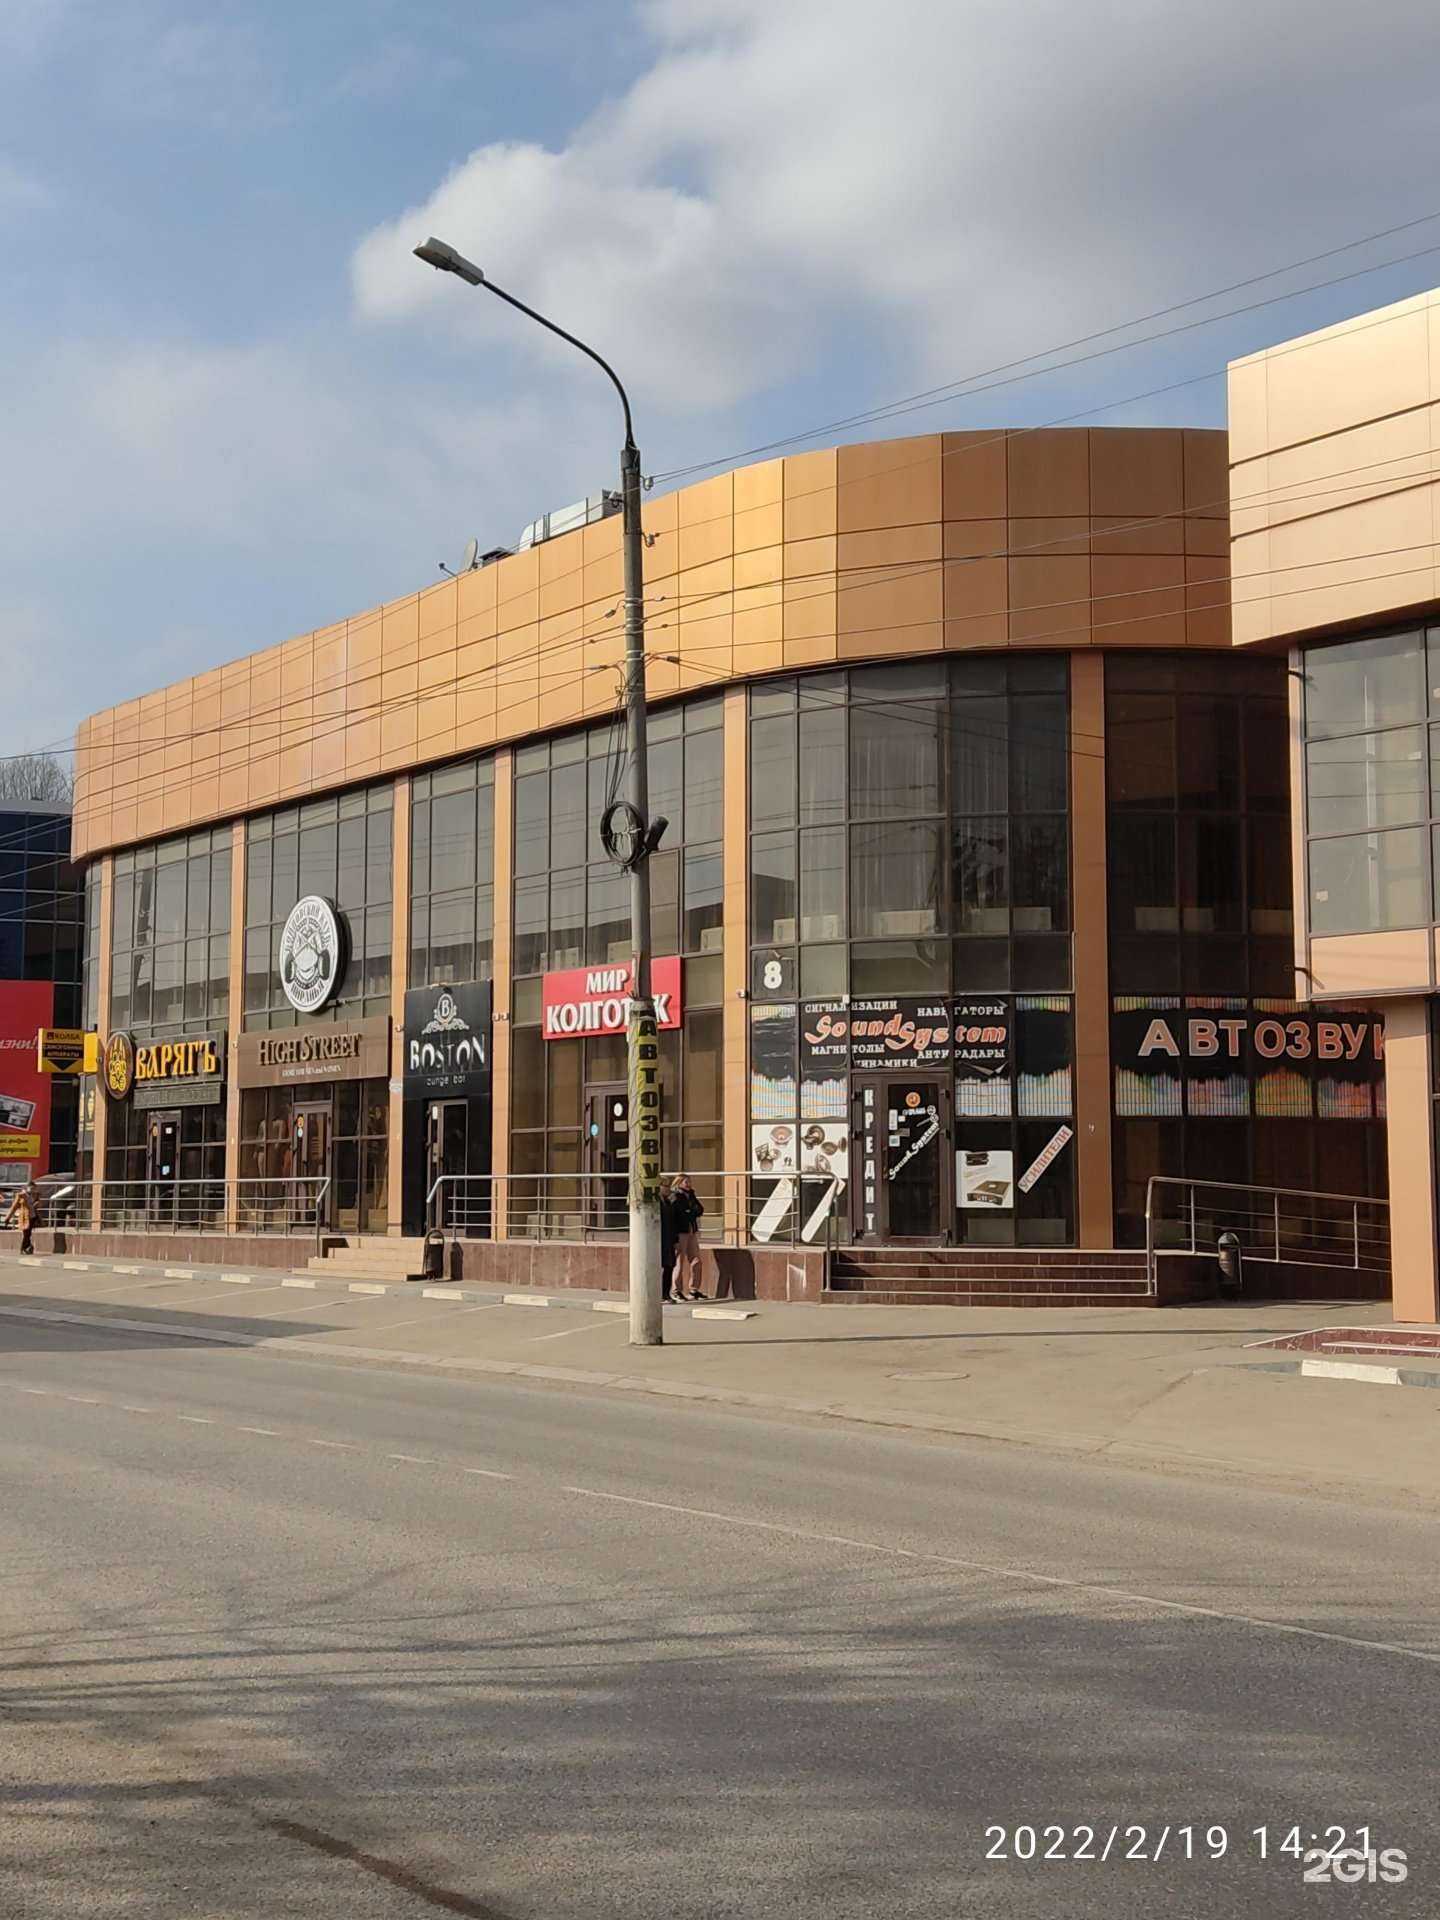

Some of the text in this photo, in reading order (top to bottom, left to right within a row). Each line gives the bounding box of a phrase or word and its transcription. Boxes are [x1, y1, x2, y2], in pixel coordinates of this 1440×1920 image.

[586, 969, 628, 994] МИР
[764, 960, 782, 989] 8
[441, 999, 450, 1017] B
[547, 993, 671, 1033] КОЛГОТК
[805, 1001, 898, 1013] СИГНАЛИЗАЦИИ
[135, 1040, 216, 1080] ВАРЯГЪ
[811, 1044, 885, 1055] МАГНИТОЛЫ
[864, 1089, 875, 1230] КРЕДИТ
